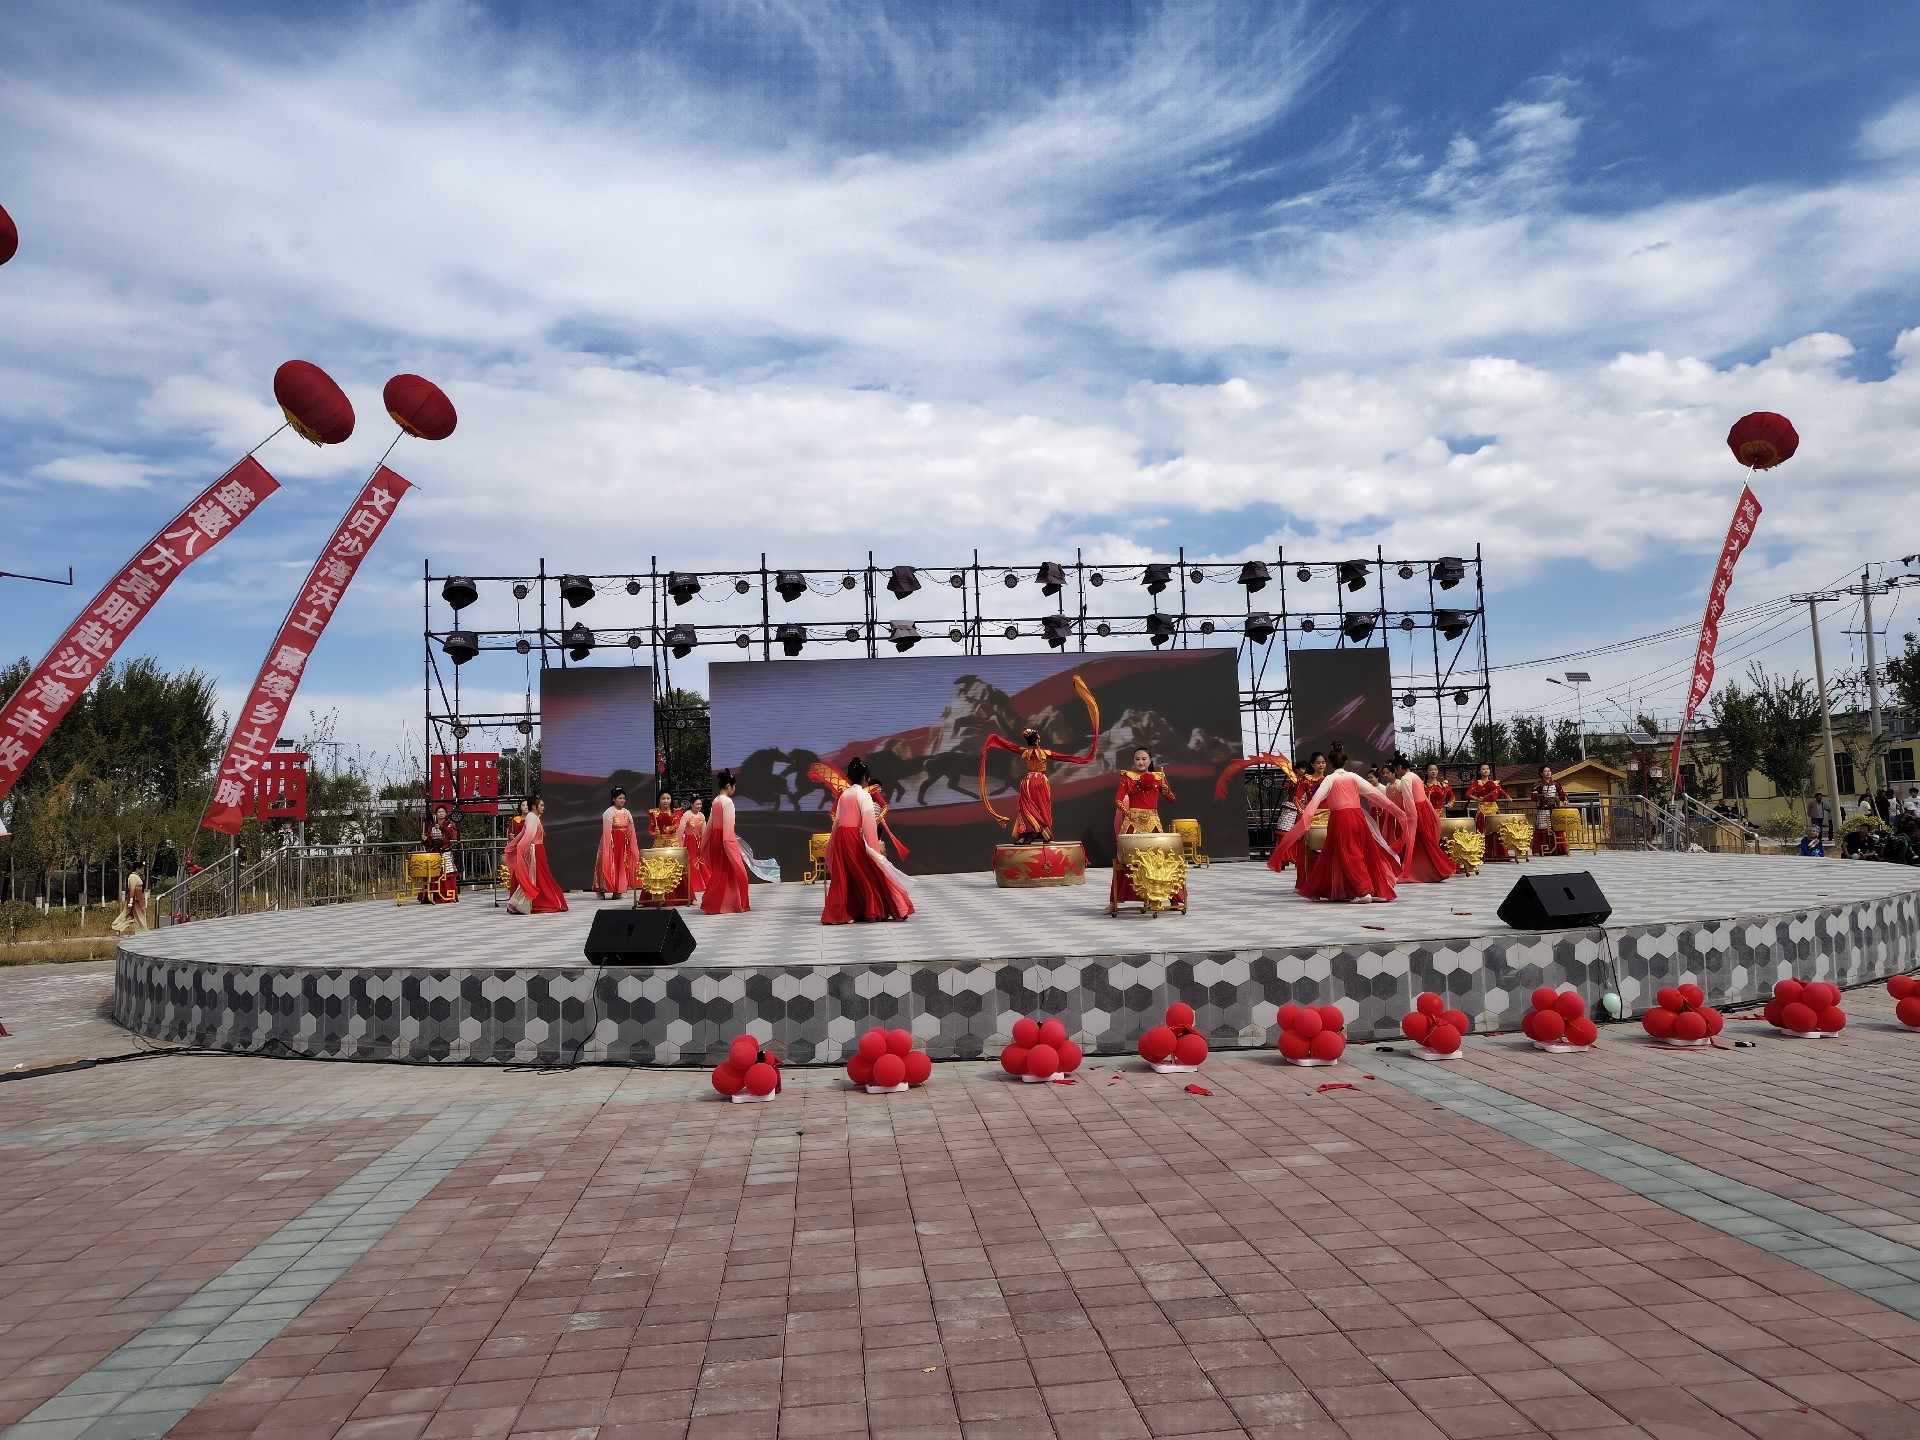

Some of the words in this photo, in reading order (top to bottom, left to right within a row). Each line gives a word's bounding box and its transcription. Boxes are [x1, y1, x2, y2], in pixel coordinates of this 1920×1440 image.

[0, 479, 257, 782] 盛邀八方宾朋赴沙湾丰收
[291, 485, 396, 638] 文归沙湾沃土
